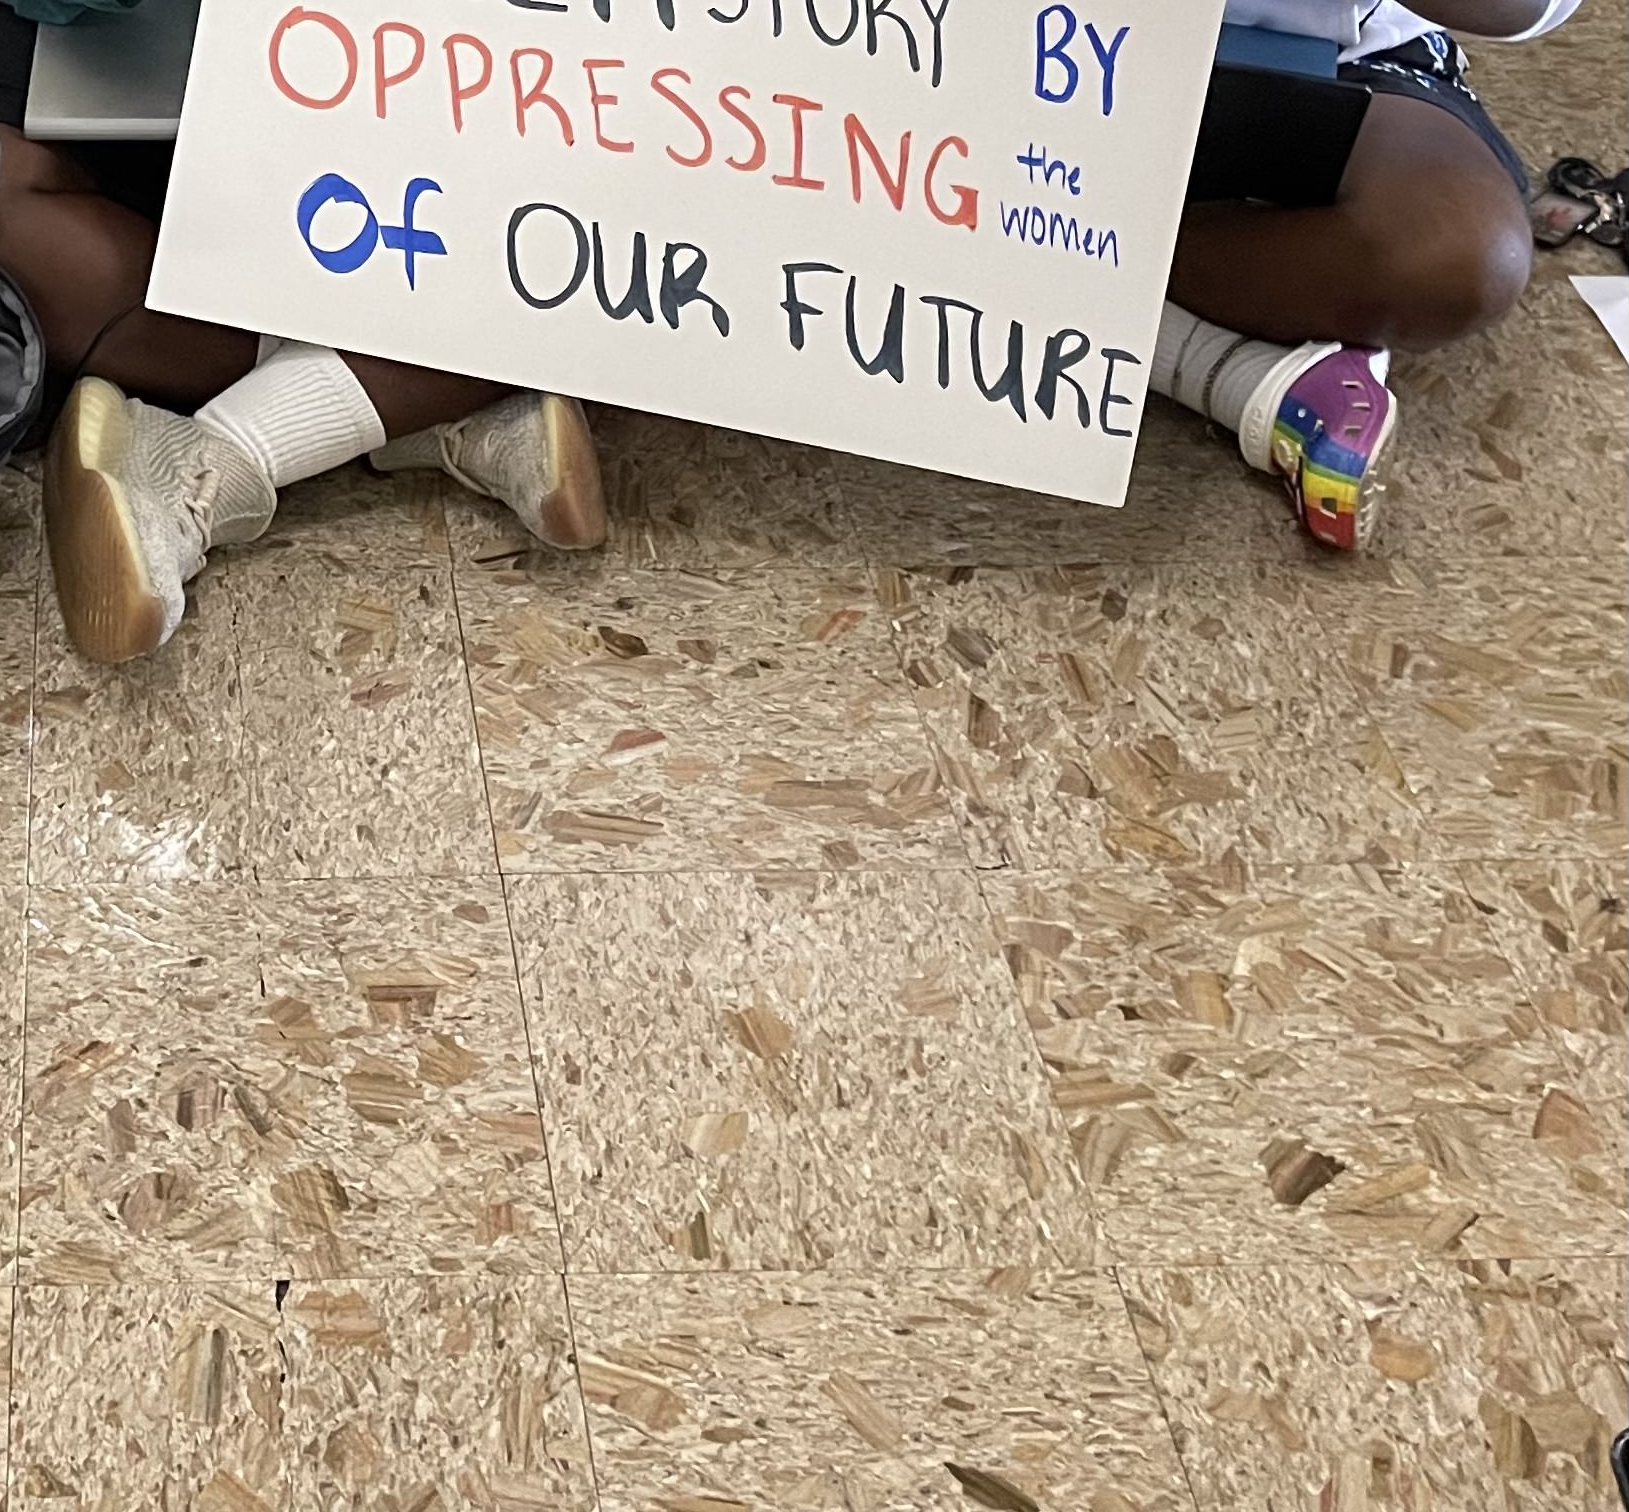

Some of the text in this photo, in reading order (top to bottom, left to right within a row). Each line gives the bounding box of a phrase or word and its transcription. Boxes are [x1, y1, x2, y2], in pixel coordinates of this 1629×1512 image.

[270, 6, 979, 232] OPPRESSING
[1034, 4, 1131, 117] BY
[1016, 142, 1081, 196] the
[506, 202, 730, 338] OUR
[779, 261, 1142, 438] FUTURE
